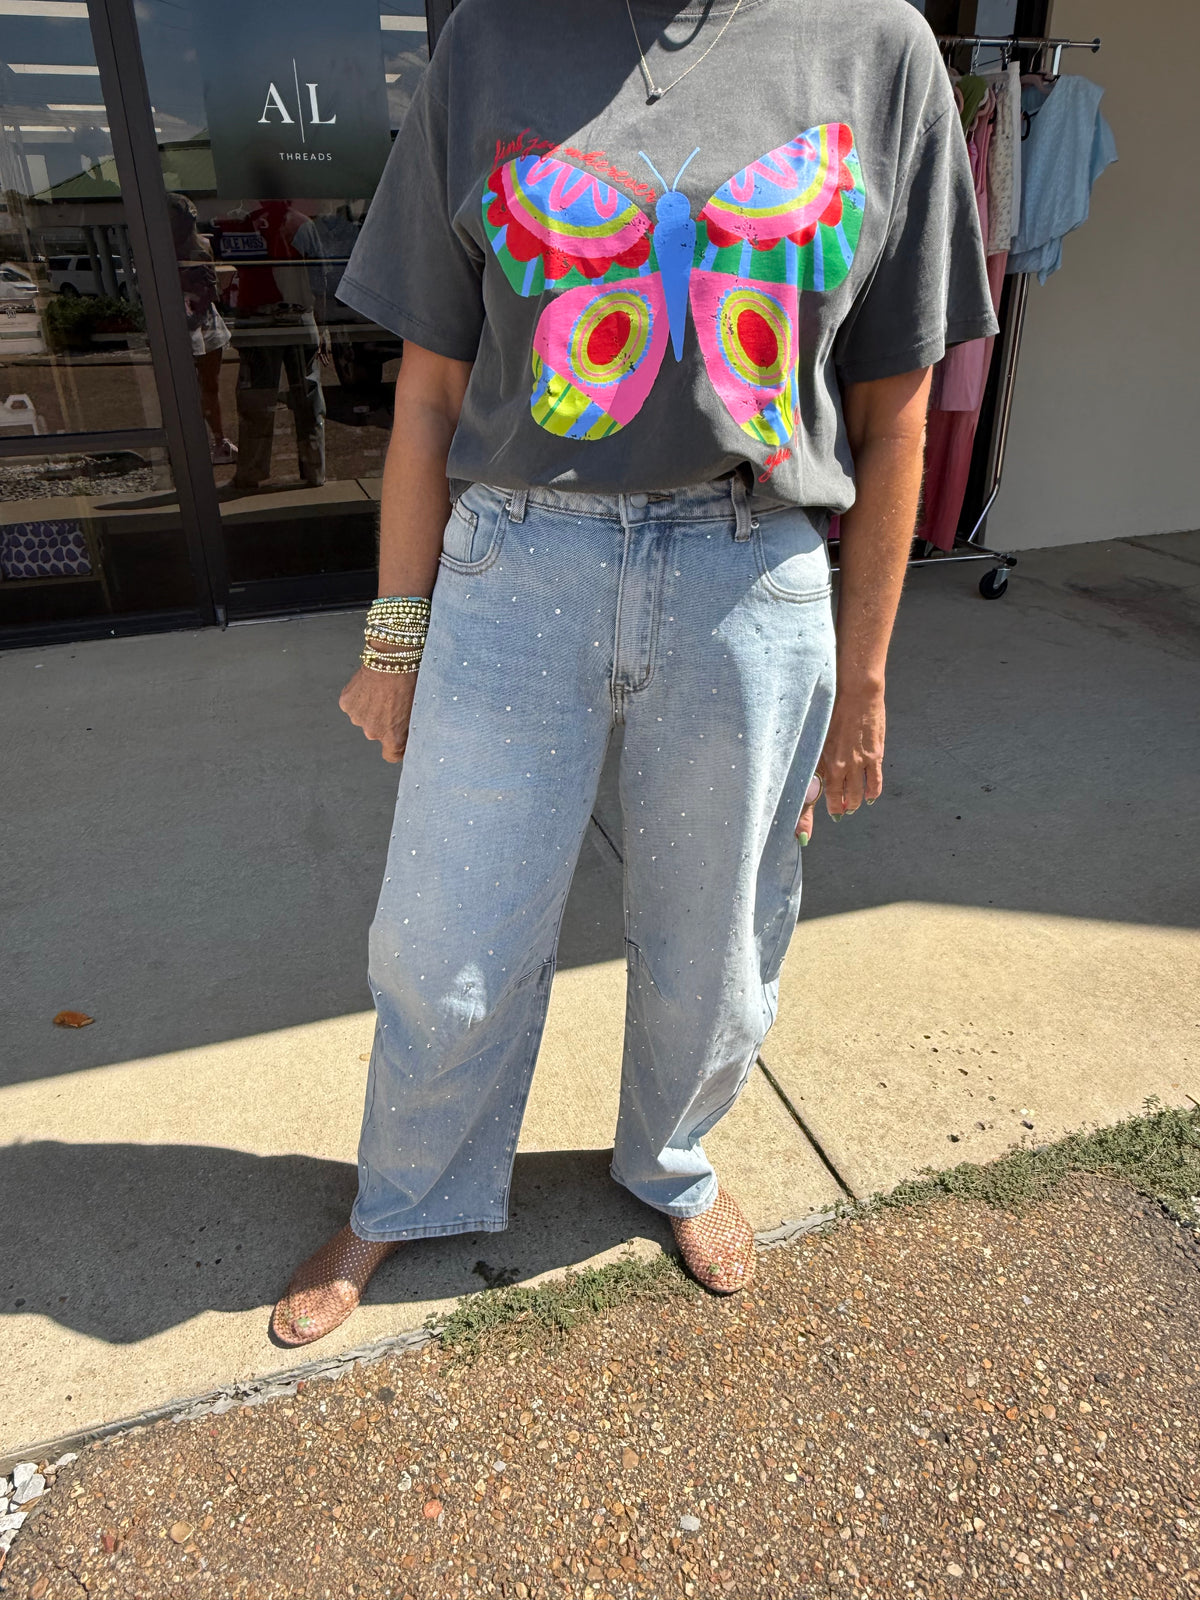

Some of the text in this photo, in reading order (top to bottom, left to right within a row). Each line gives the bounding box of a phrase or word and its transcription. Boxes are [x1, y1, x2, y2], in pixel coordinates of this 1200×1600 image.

[279, 152, 332, 161] THREADS
[491, 127, 531, 172] find
[563, 146, 657, 203] wherever
[222, 236, 241, 249] OLE
